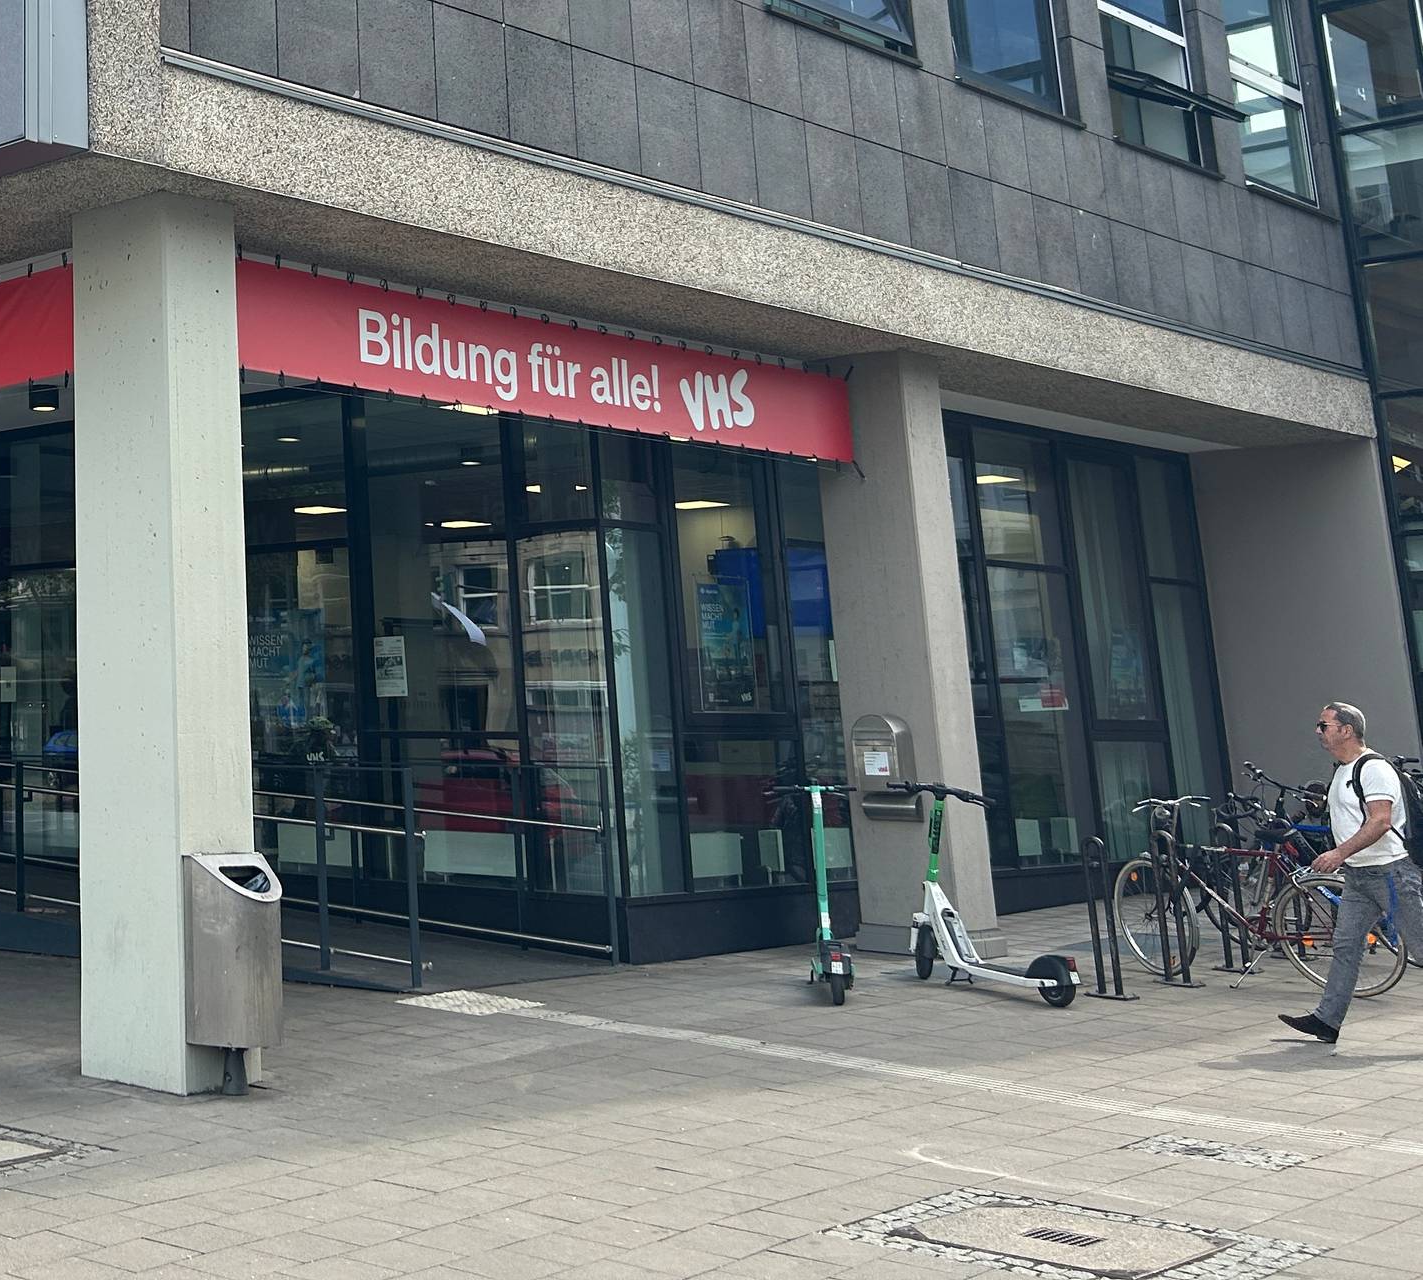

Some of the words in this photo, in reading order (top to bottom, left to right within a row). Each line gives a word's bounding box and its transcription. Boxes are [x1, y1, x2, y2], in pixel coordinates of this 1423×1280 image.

[357, 307, 519, 402] Bildung
[526, 342, 581, 398] für
[589, 354, 662, 413] alle!
[678, 368, 756, 432] VHS
